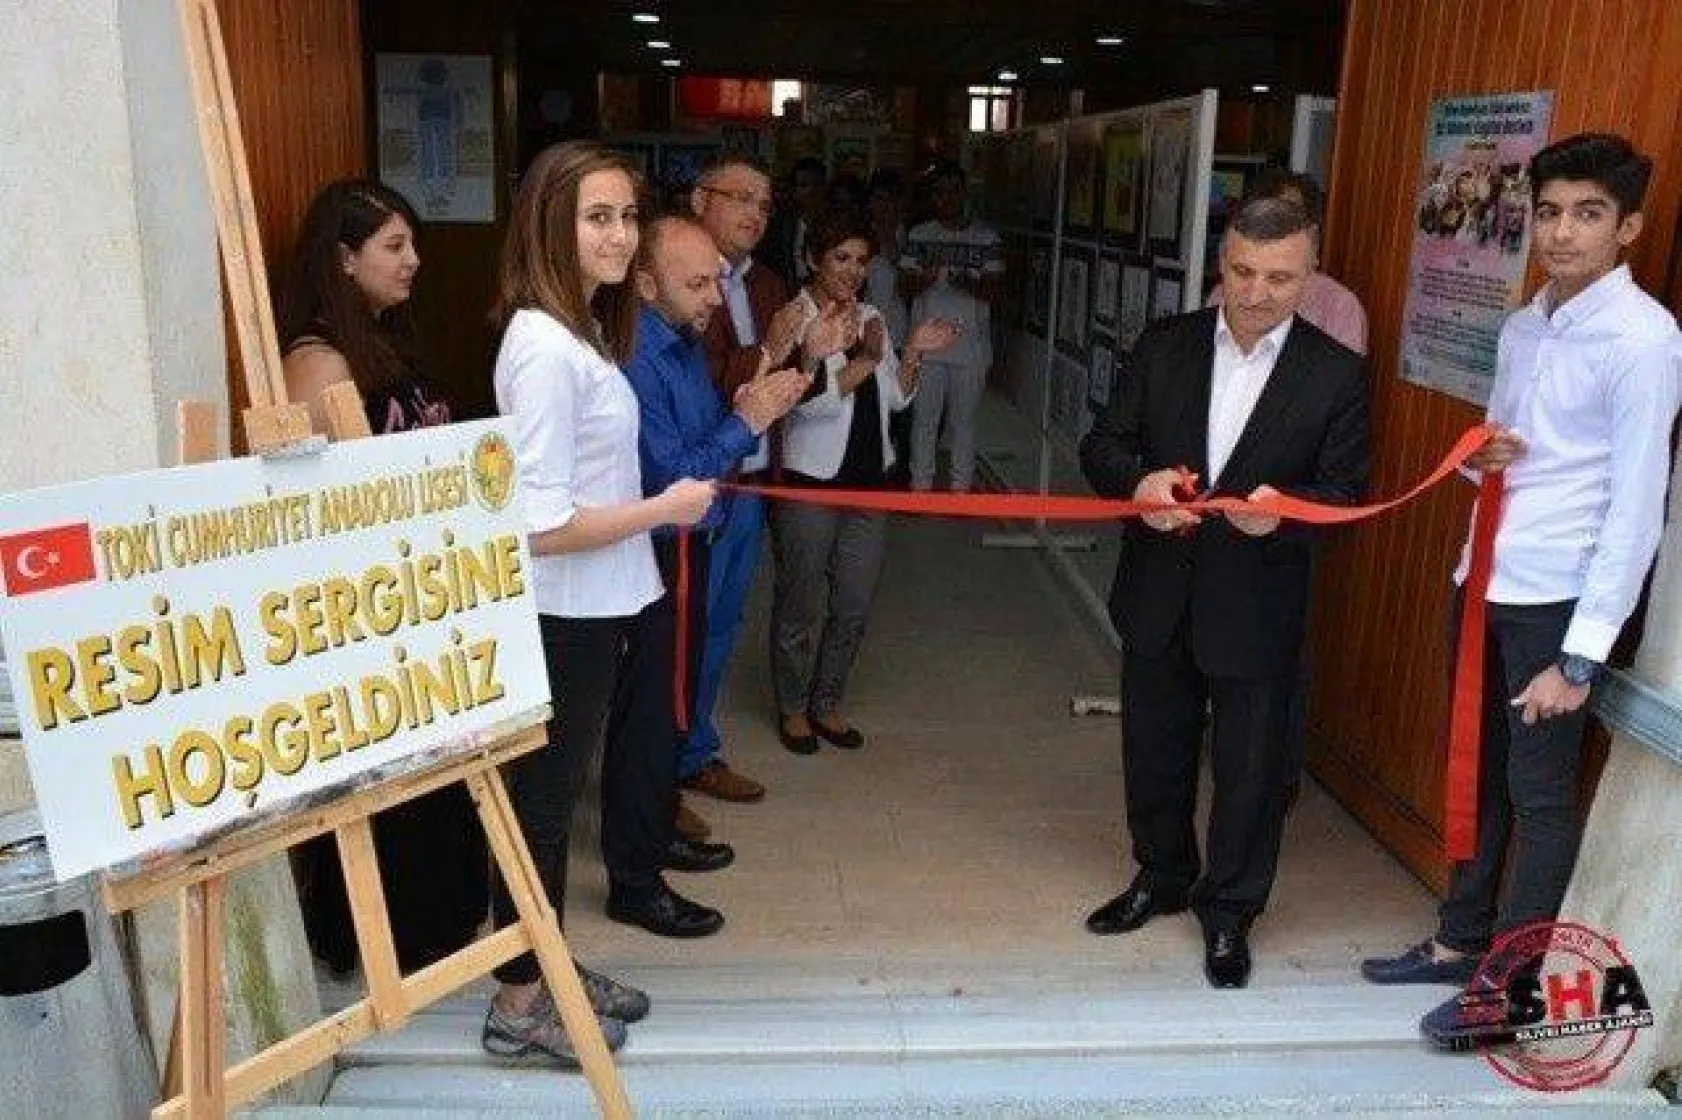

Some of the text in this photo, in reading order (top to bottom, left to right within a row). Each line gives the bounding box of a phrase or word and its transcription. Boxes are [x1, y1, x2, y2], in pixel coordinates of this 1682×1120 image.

[97, 452, 470, 580] TOKİ CUMHURİYET ANADOLU LİSESİ
[27, 528, 524, 731] RESİM SERGİSİNE
[112, 628, 505, 829] HOŞGELDİNİZ
